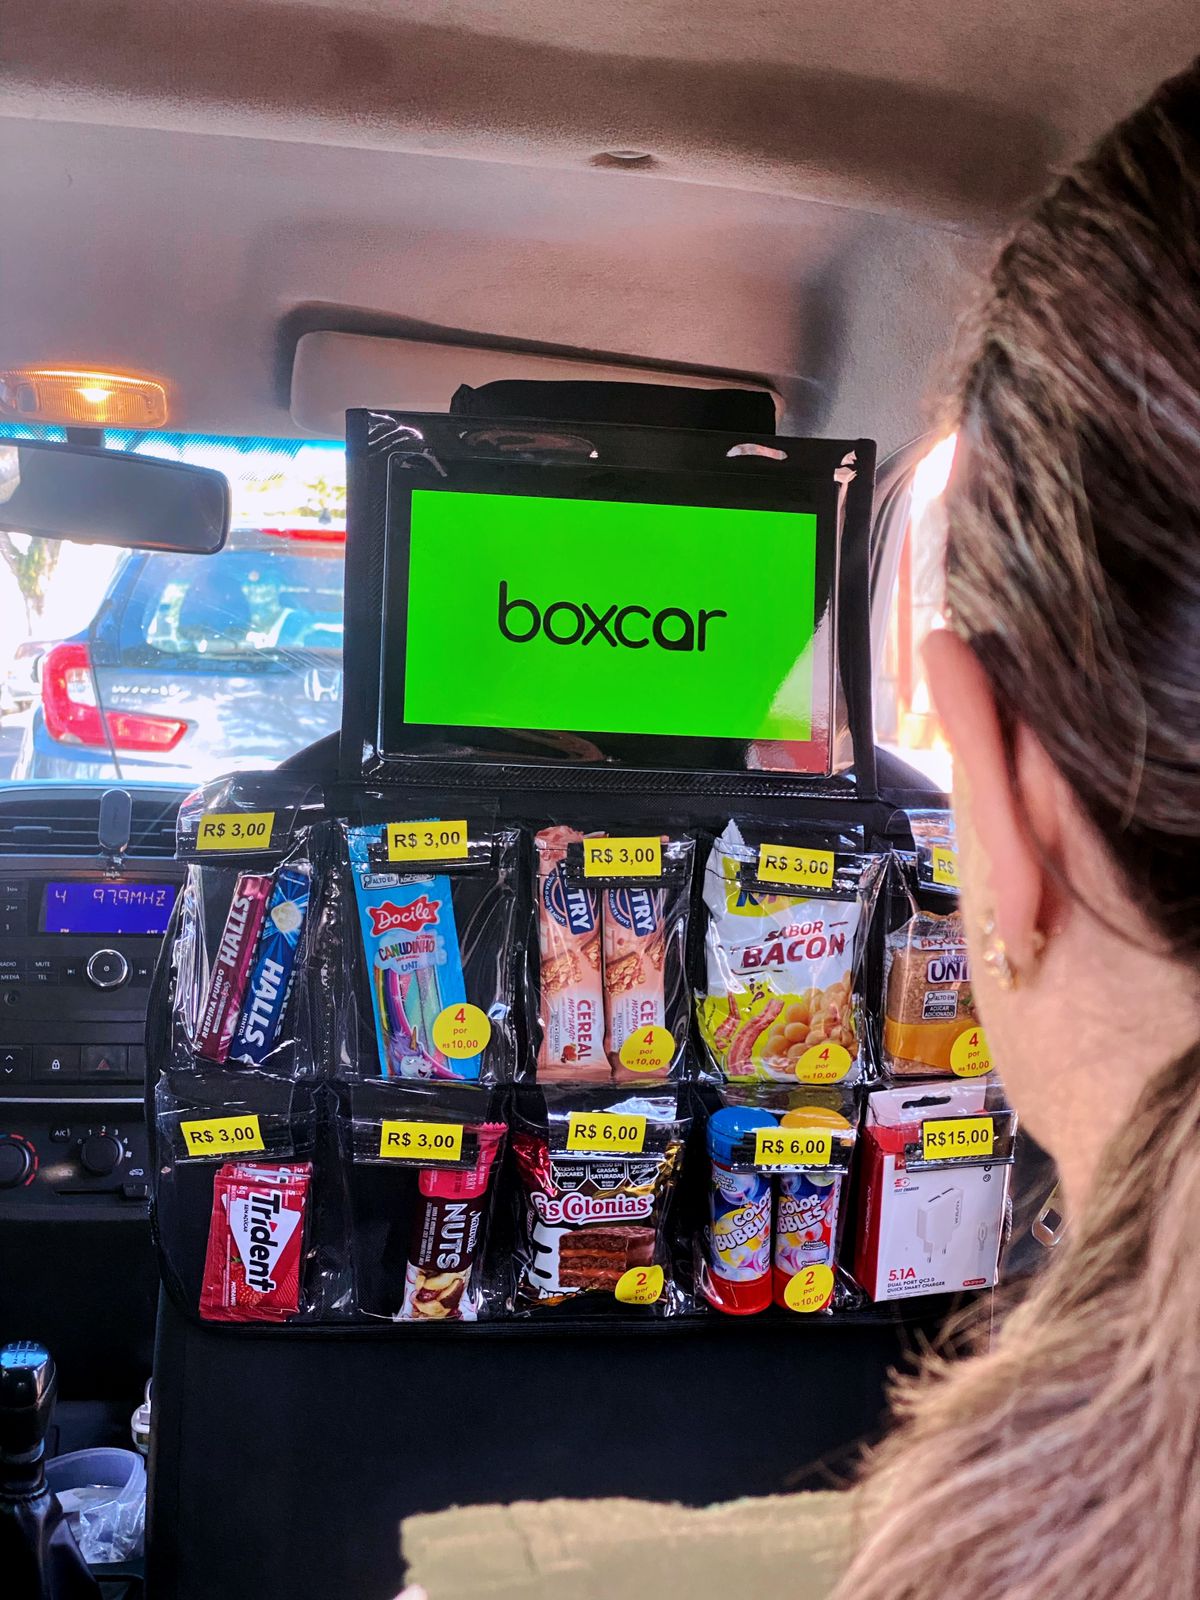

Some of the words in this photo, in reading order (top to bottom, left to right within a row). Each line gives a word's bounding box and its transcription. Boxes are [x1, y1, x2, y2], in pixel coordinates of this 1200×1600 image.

[498, 580, 727, 652] boxcar
[204, 823, 226, 838] R$
[231, 823, 266, 838] 3,00
[394, 832, 418, 848] R$
[424, 831, 460, 848] 3,00
[591, 848, 613, 864] R$
[619, 848, 655, 865] 3,00
[765, 855, 788, 871] R$
[794, 858, 829, 875] 3,00
[55, 889, 67, 904] 4
[375, 902, 433, 929] Docile
[219, 895, 255, 968] HALLS
[764, 921, 824, 942] SABOR
[378, 941, 436, 962] CANUDINHO
[741, 932, 846, 968] BACON
[201, 1001, 217, 1040] RESPIRA
[210, 967, 226, 1001] FUNDO
[245, 957, 286, 1049] HALLS
[454, 1008, 466, 1023] 4
[630, 1000, 638, 1034] moran
[453, 1028, 468, 1037] por
[577, 1000, 592, 1061] CEREAL
[643, 1030, 654, 1045] 4
[451, 1039, 479, 1050] 10,00
[969, 1032, 979, 1047] 4
[819, 1048, 830, 1061] 4
[968, 1051, 980, 1059] por
[55, 1129, 66, 1137] A/C
[190, 1130, 214, 1144] R$
[219, 1127, 254, 1144] 3,00
[387, 1132, 412, 1147] R$
[417, 1133, 454, 1149] 3,00
[574, 1124, 597, 1140] R$
[603, 1126, 638, 1141] 6,00
[762, 1139, 785, 1154] R$
[790, 1140, 825, 1155] 6,00
[563, 1194, 649, 1221] Colonias
[779, 1194, 821, 1216] COLOR
[437, 1203, 468, 1269] NUTS
[715, 1206, 771, 1252] BUBBLE
[248, 1193, 281, 1292] Trident
[636, 1272, 648, 1286] 2
[805, 1271, 815, 1285] 2
[888, 1267, 916, 1282] 5.1A
[803, 1287, 815, 1295] por
[921, 1281, 945, 1289] CHARGER
